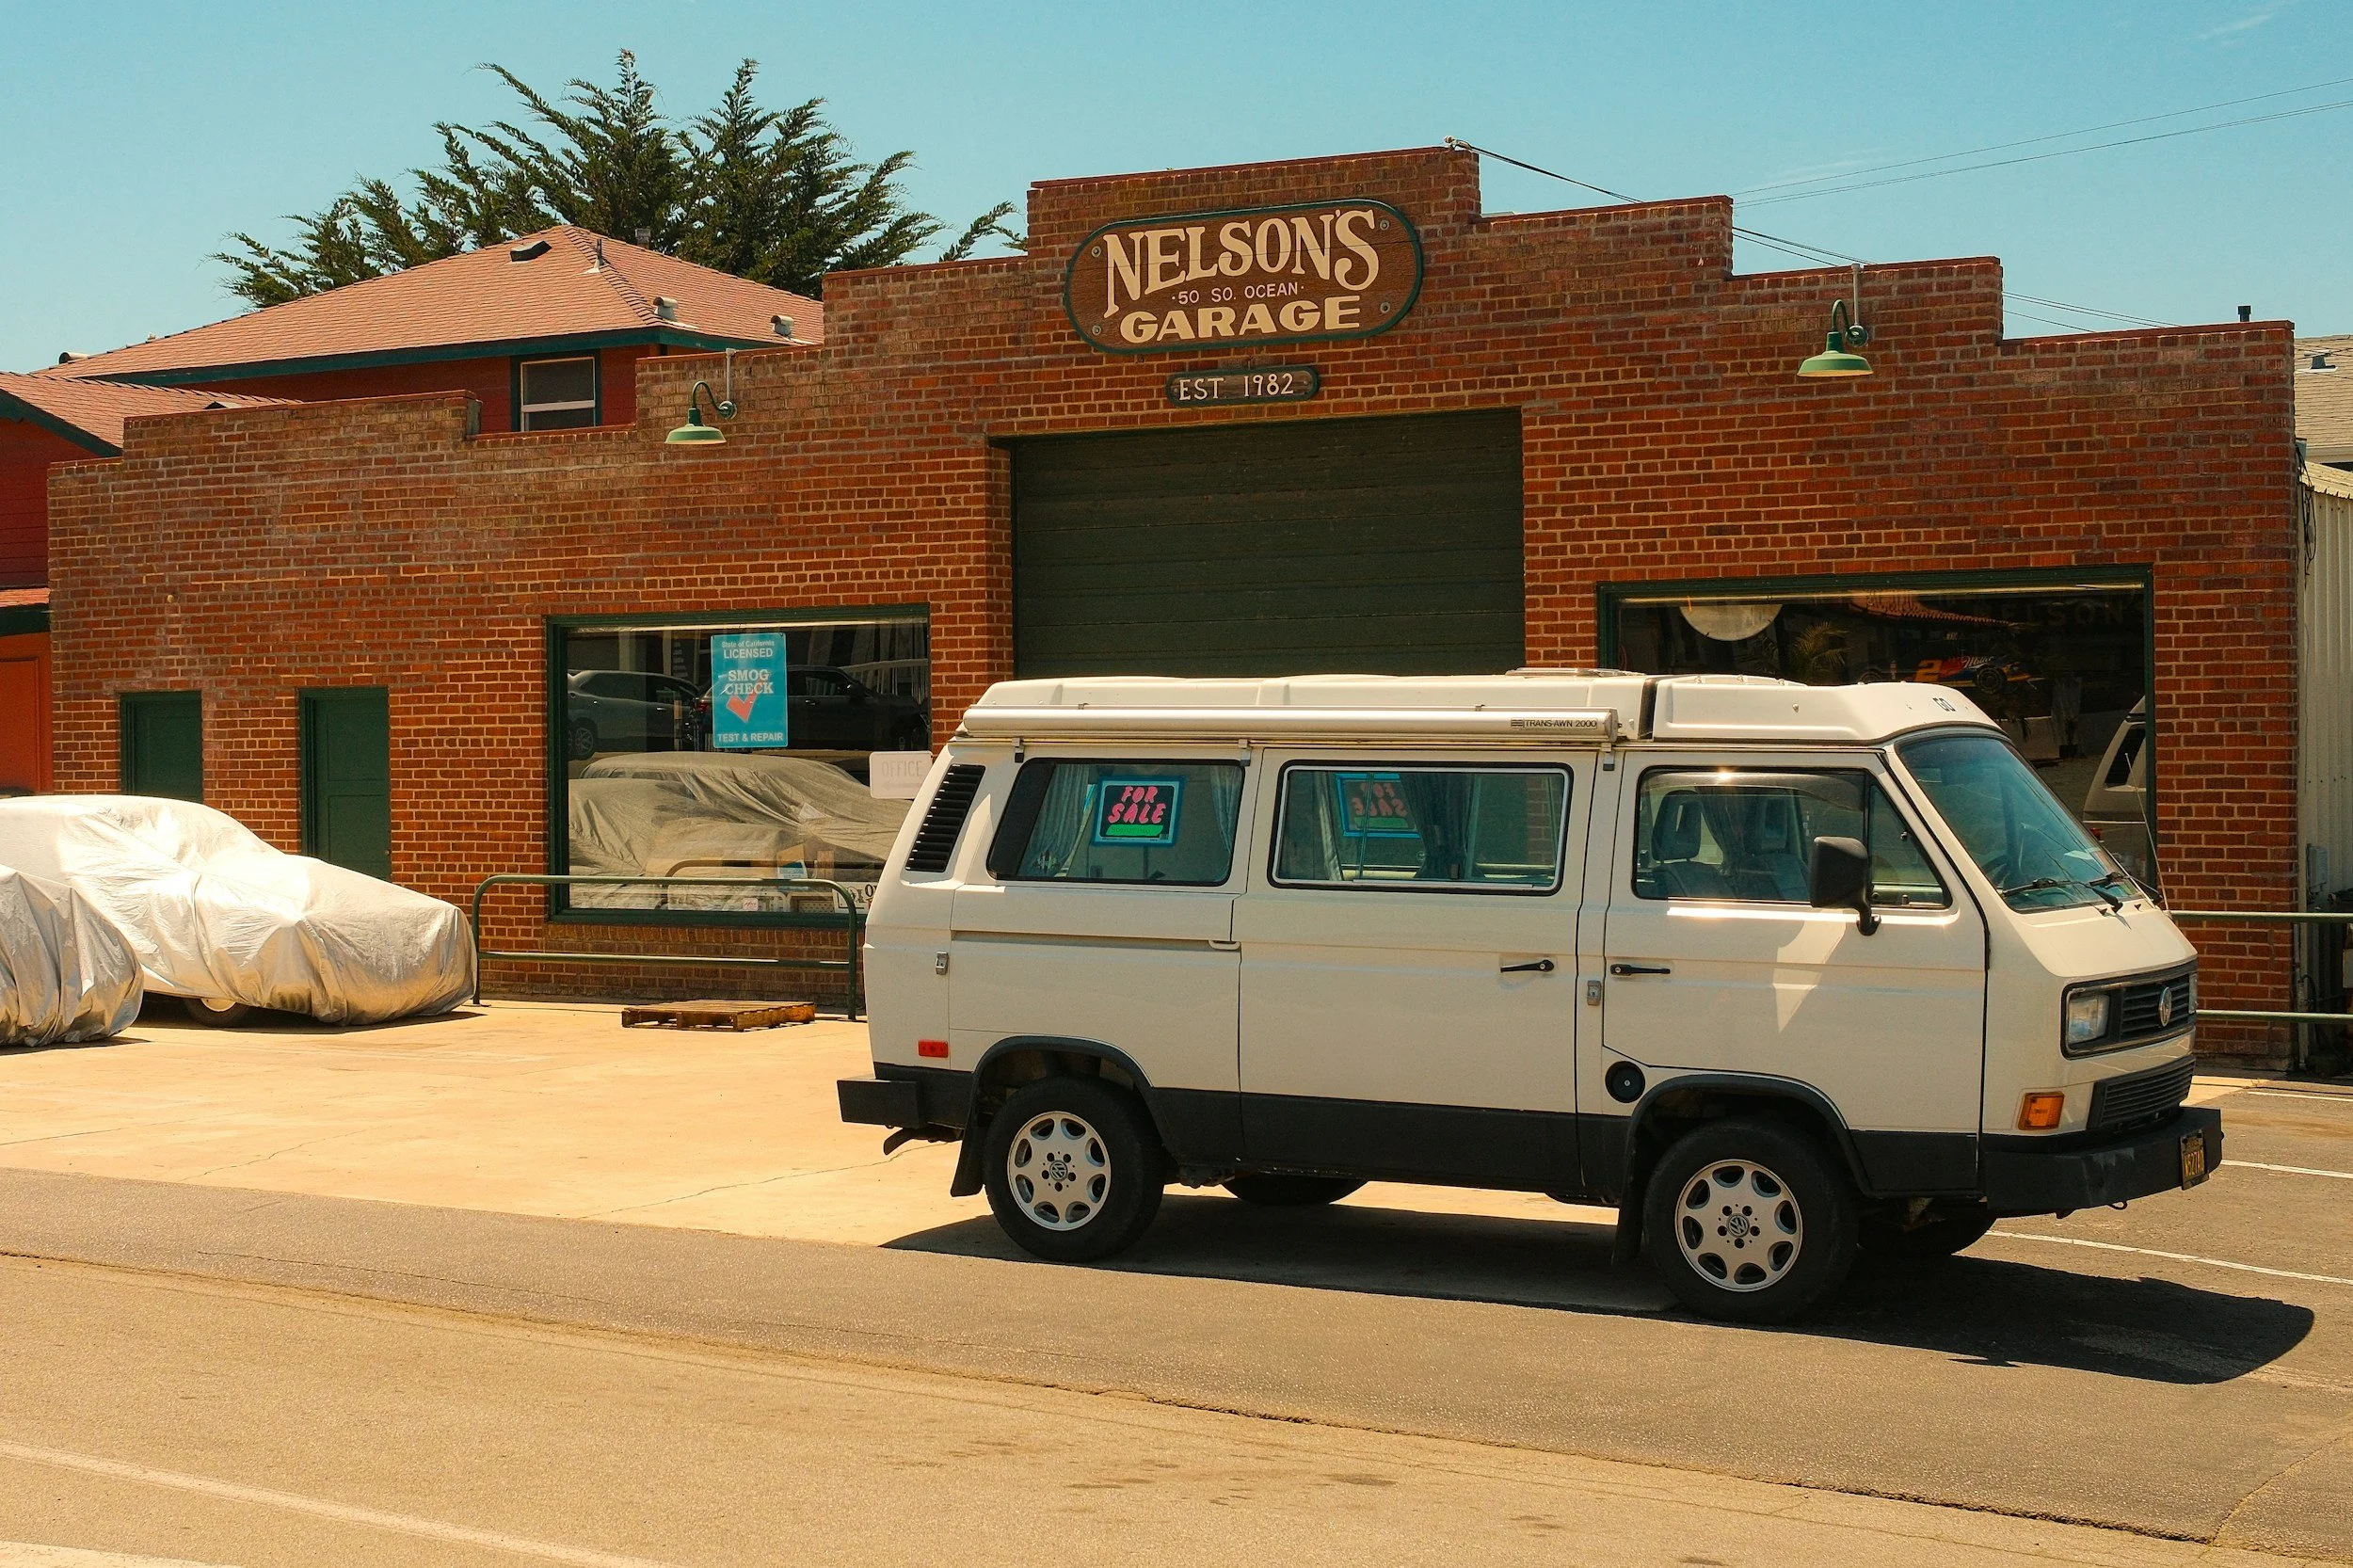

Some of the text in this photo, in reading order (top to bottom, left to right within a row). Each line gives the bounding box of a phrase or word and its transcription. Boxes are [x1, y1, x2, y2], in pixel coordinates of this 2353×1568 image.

[1103, 208, 1380, 319] NELSON'S
[1177, 281, 1299, 305] 50 SO. OCEAN
[1119, 295, 1361, 344] GARAGE
[1242, 373, 1294, 397] 1982
[745, 639, 775, 648] California
[723, 648, 773, 659] LICENSED
[728, 668, 770, 681] SMOG
[725, 681, 774, 696] CHECK
[1525, 719, 1597, 728] TRANS-AWN 2000
[718, 732, 784, 743] TEST & REPAIR
[881, 760, 923, 777] OFFICE
[1121, 785, 1159, 804] FOR
[1107, 803, 1167, 824] SALE
